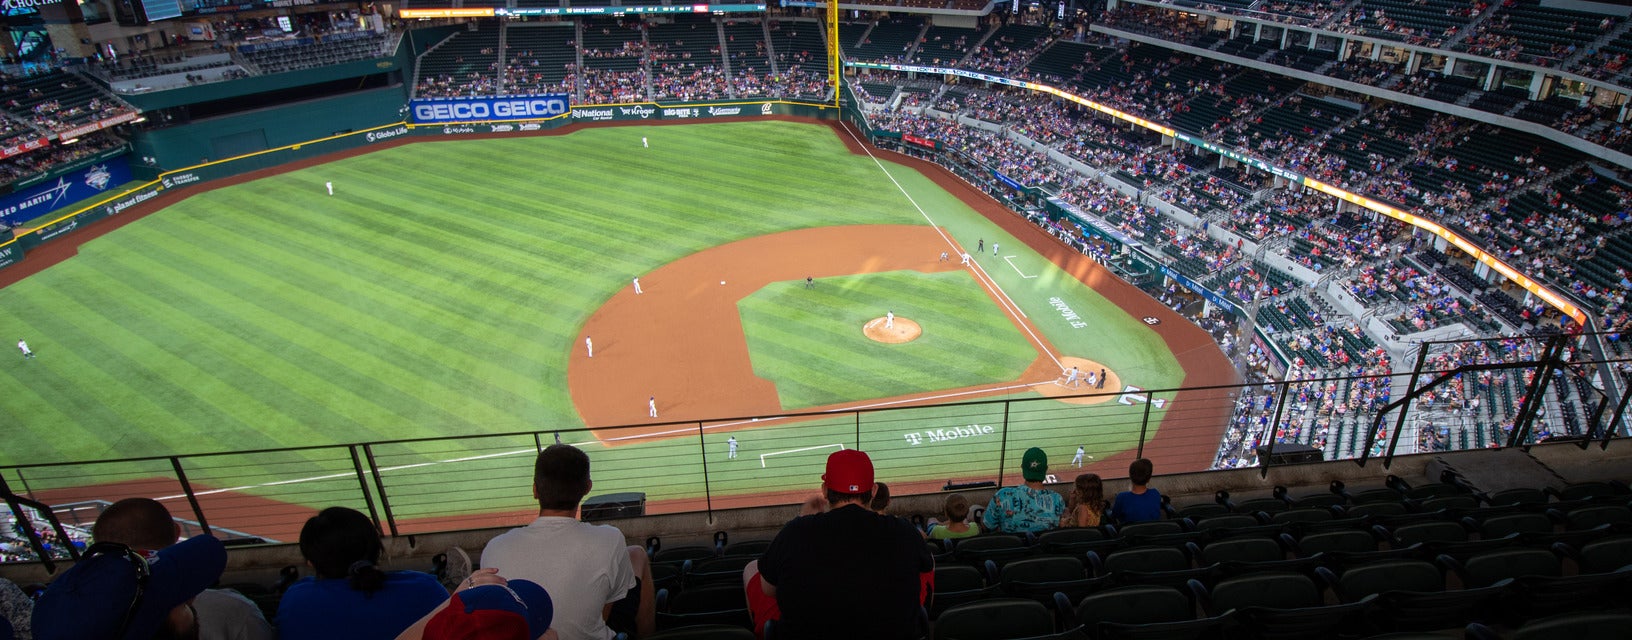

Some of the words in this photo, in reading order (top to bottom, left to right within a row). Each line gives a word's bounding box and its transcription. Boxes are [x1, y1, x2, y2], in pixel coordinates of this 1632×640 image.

[415, 102, 490, 120] GEICO
[493, 100, 565, 117] GEICO
[581, 108, 613, 118] National
[631, 105, 655, 118] Kroger
[376, 130, 396, 139] Globe
[396, 126, 408, 135] Life
[19, 193, 53, 210] MARTIN
[113, 197, 137, 213] planet
[136, 190, 158, 203] fitness
[1048, 296, 1081, 321] Mobile
[903, 432, 922, 446] T
[925, 424, 995, 443] Mobile
